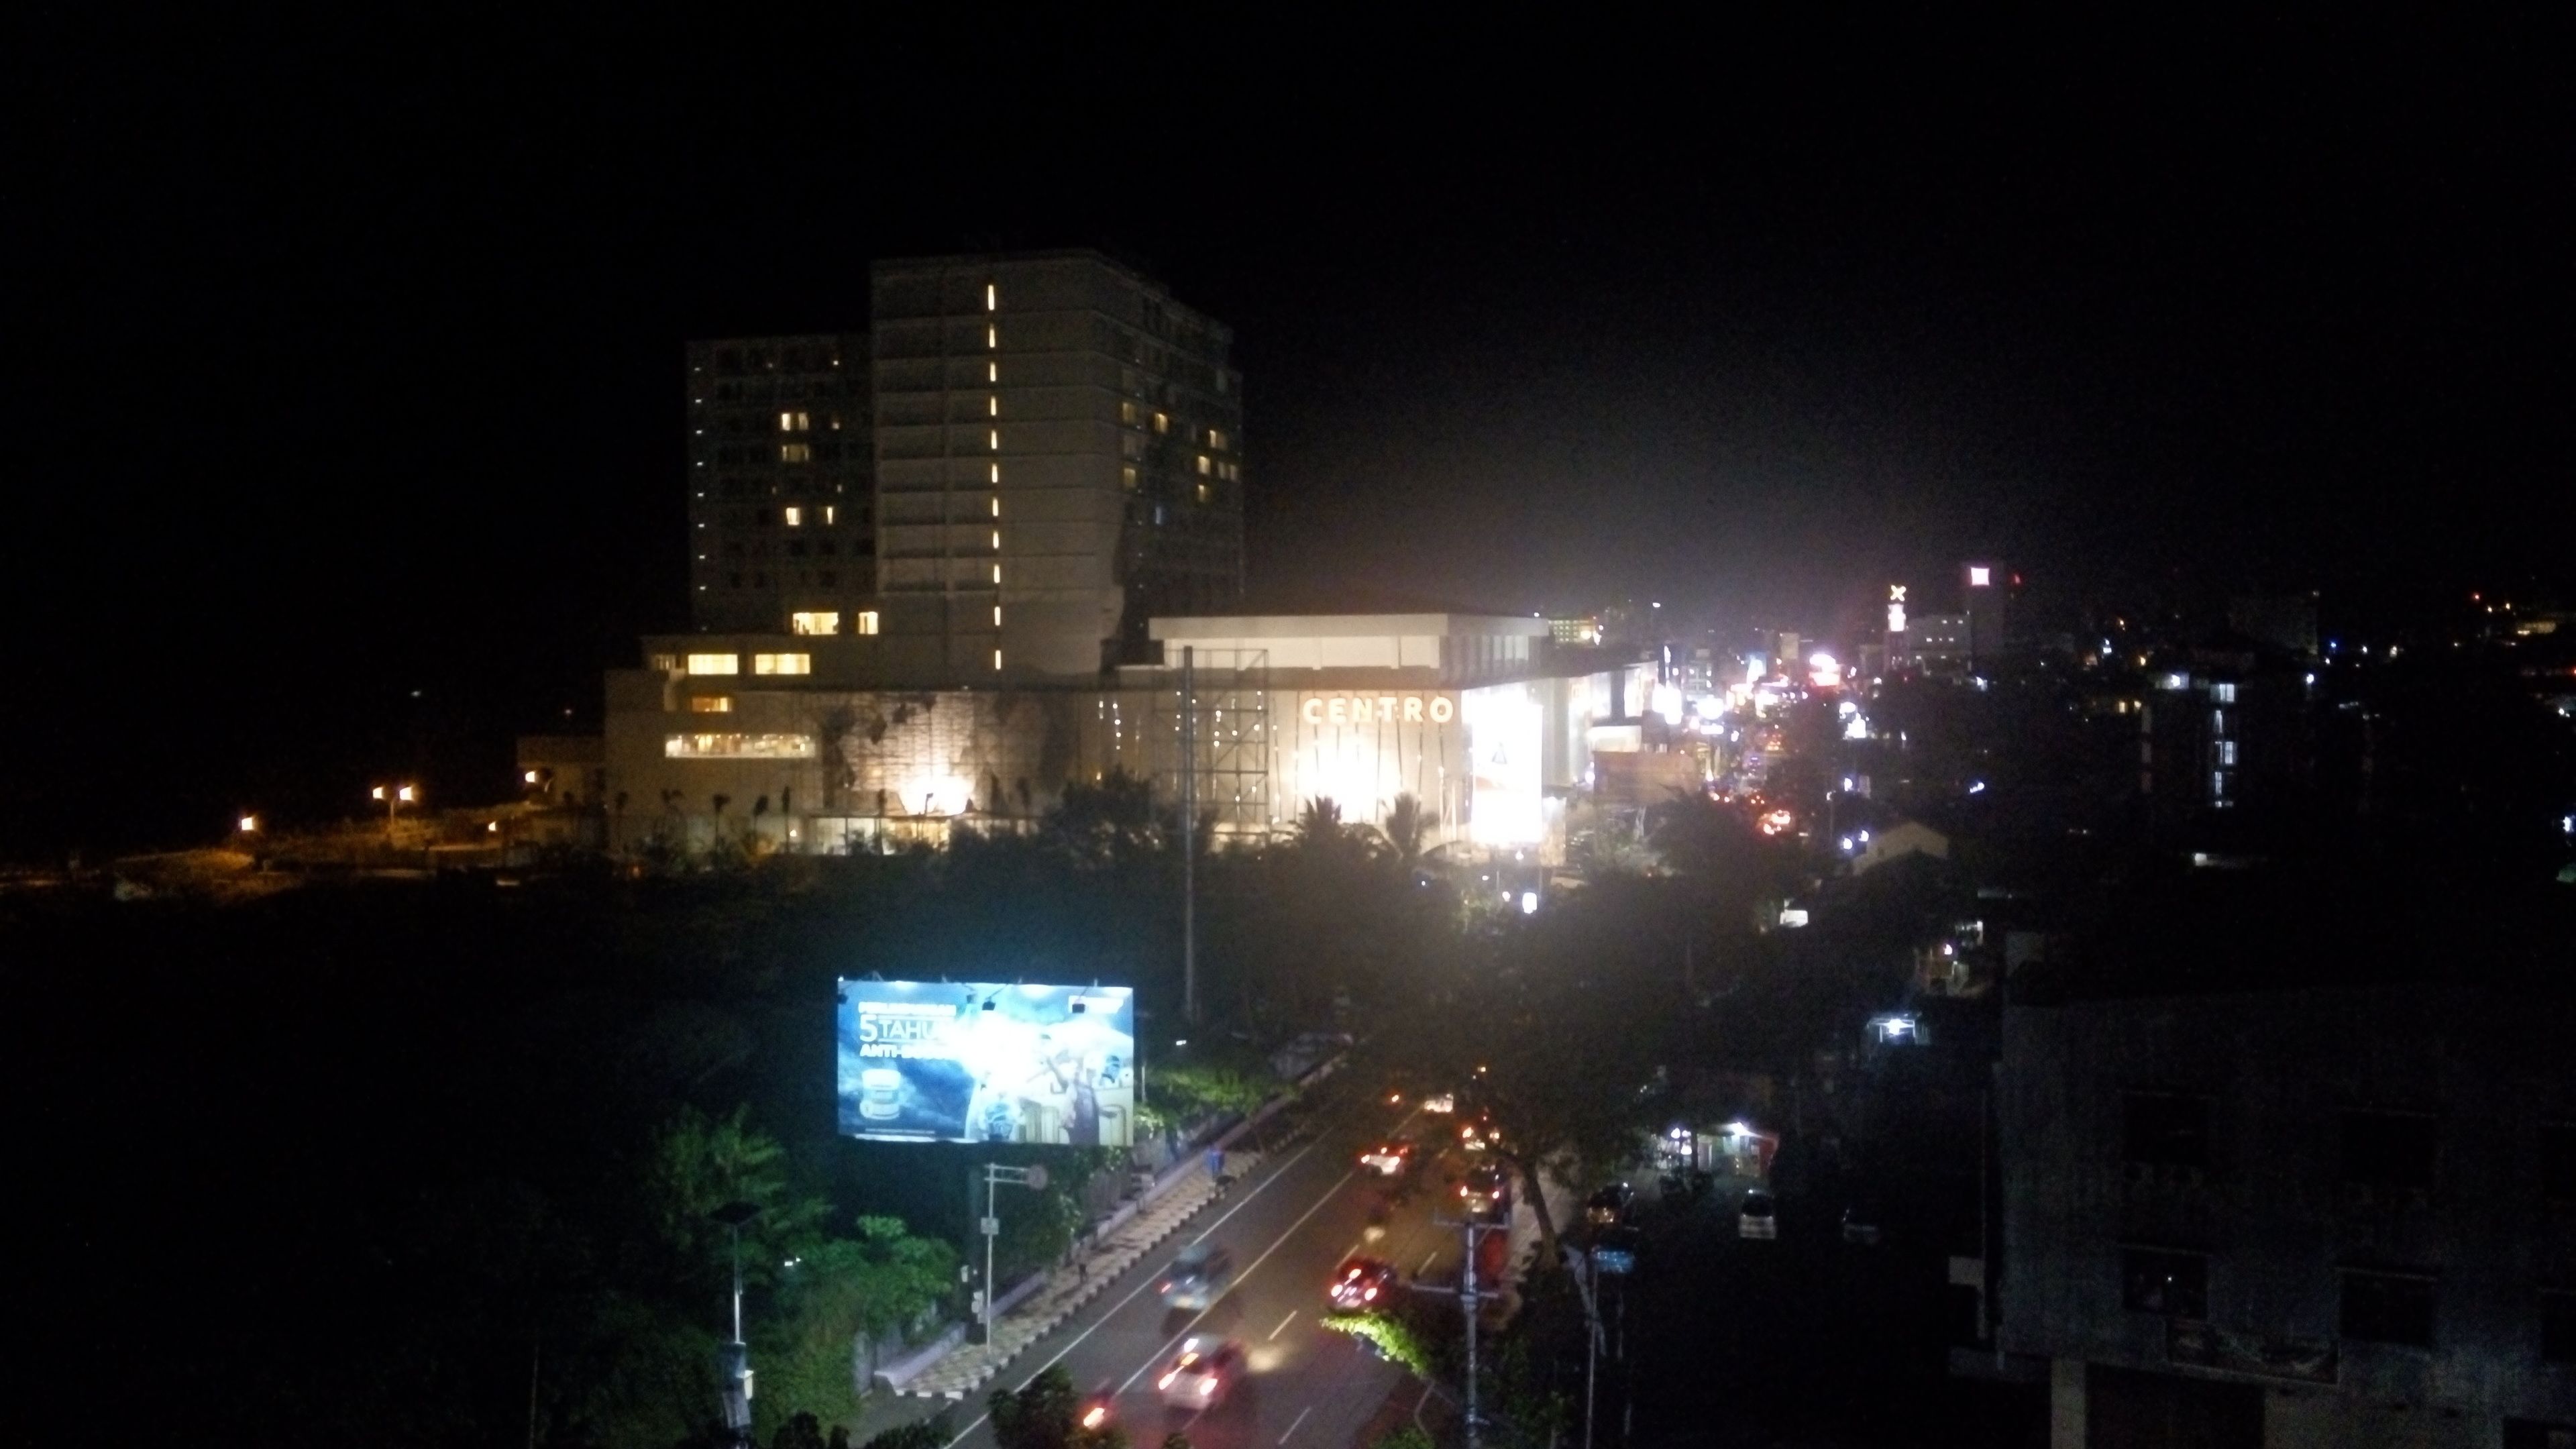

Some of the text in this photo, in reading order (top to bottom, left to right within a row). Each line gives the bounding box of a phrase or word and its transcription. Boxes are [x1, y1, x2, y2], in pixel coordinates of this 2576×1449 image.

[1302, 695, 1454, 724] CENTRO
[861, 1014, 945, 1042] 5 TAHU
